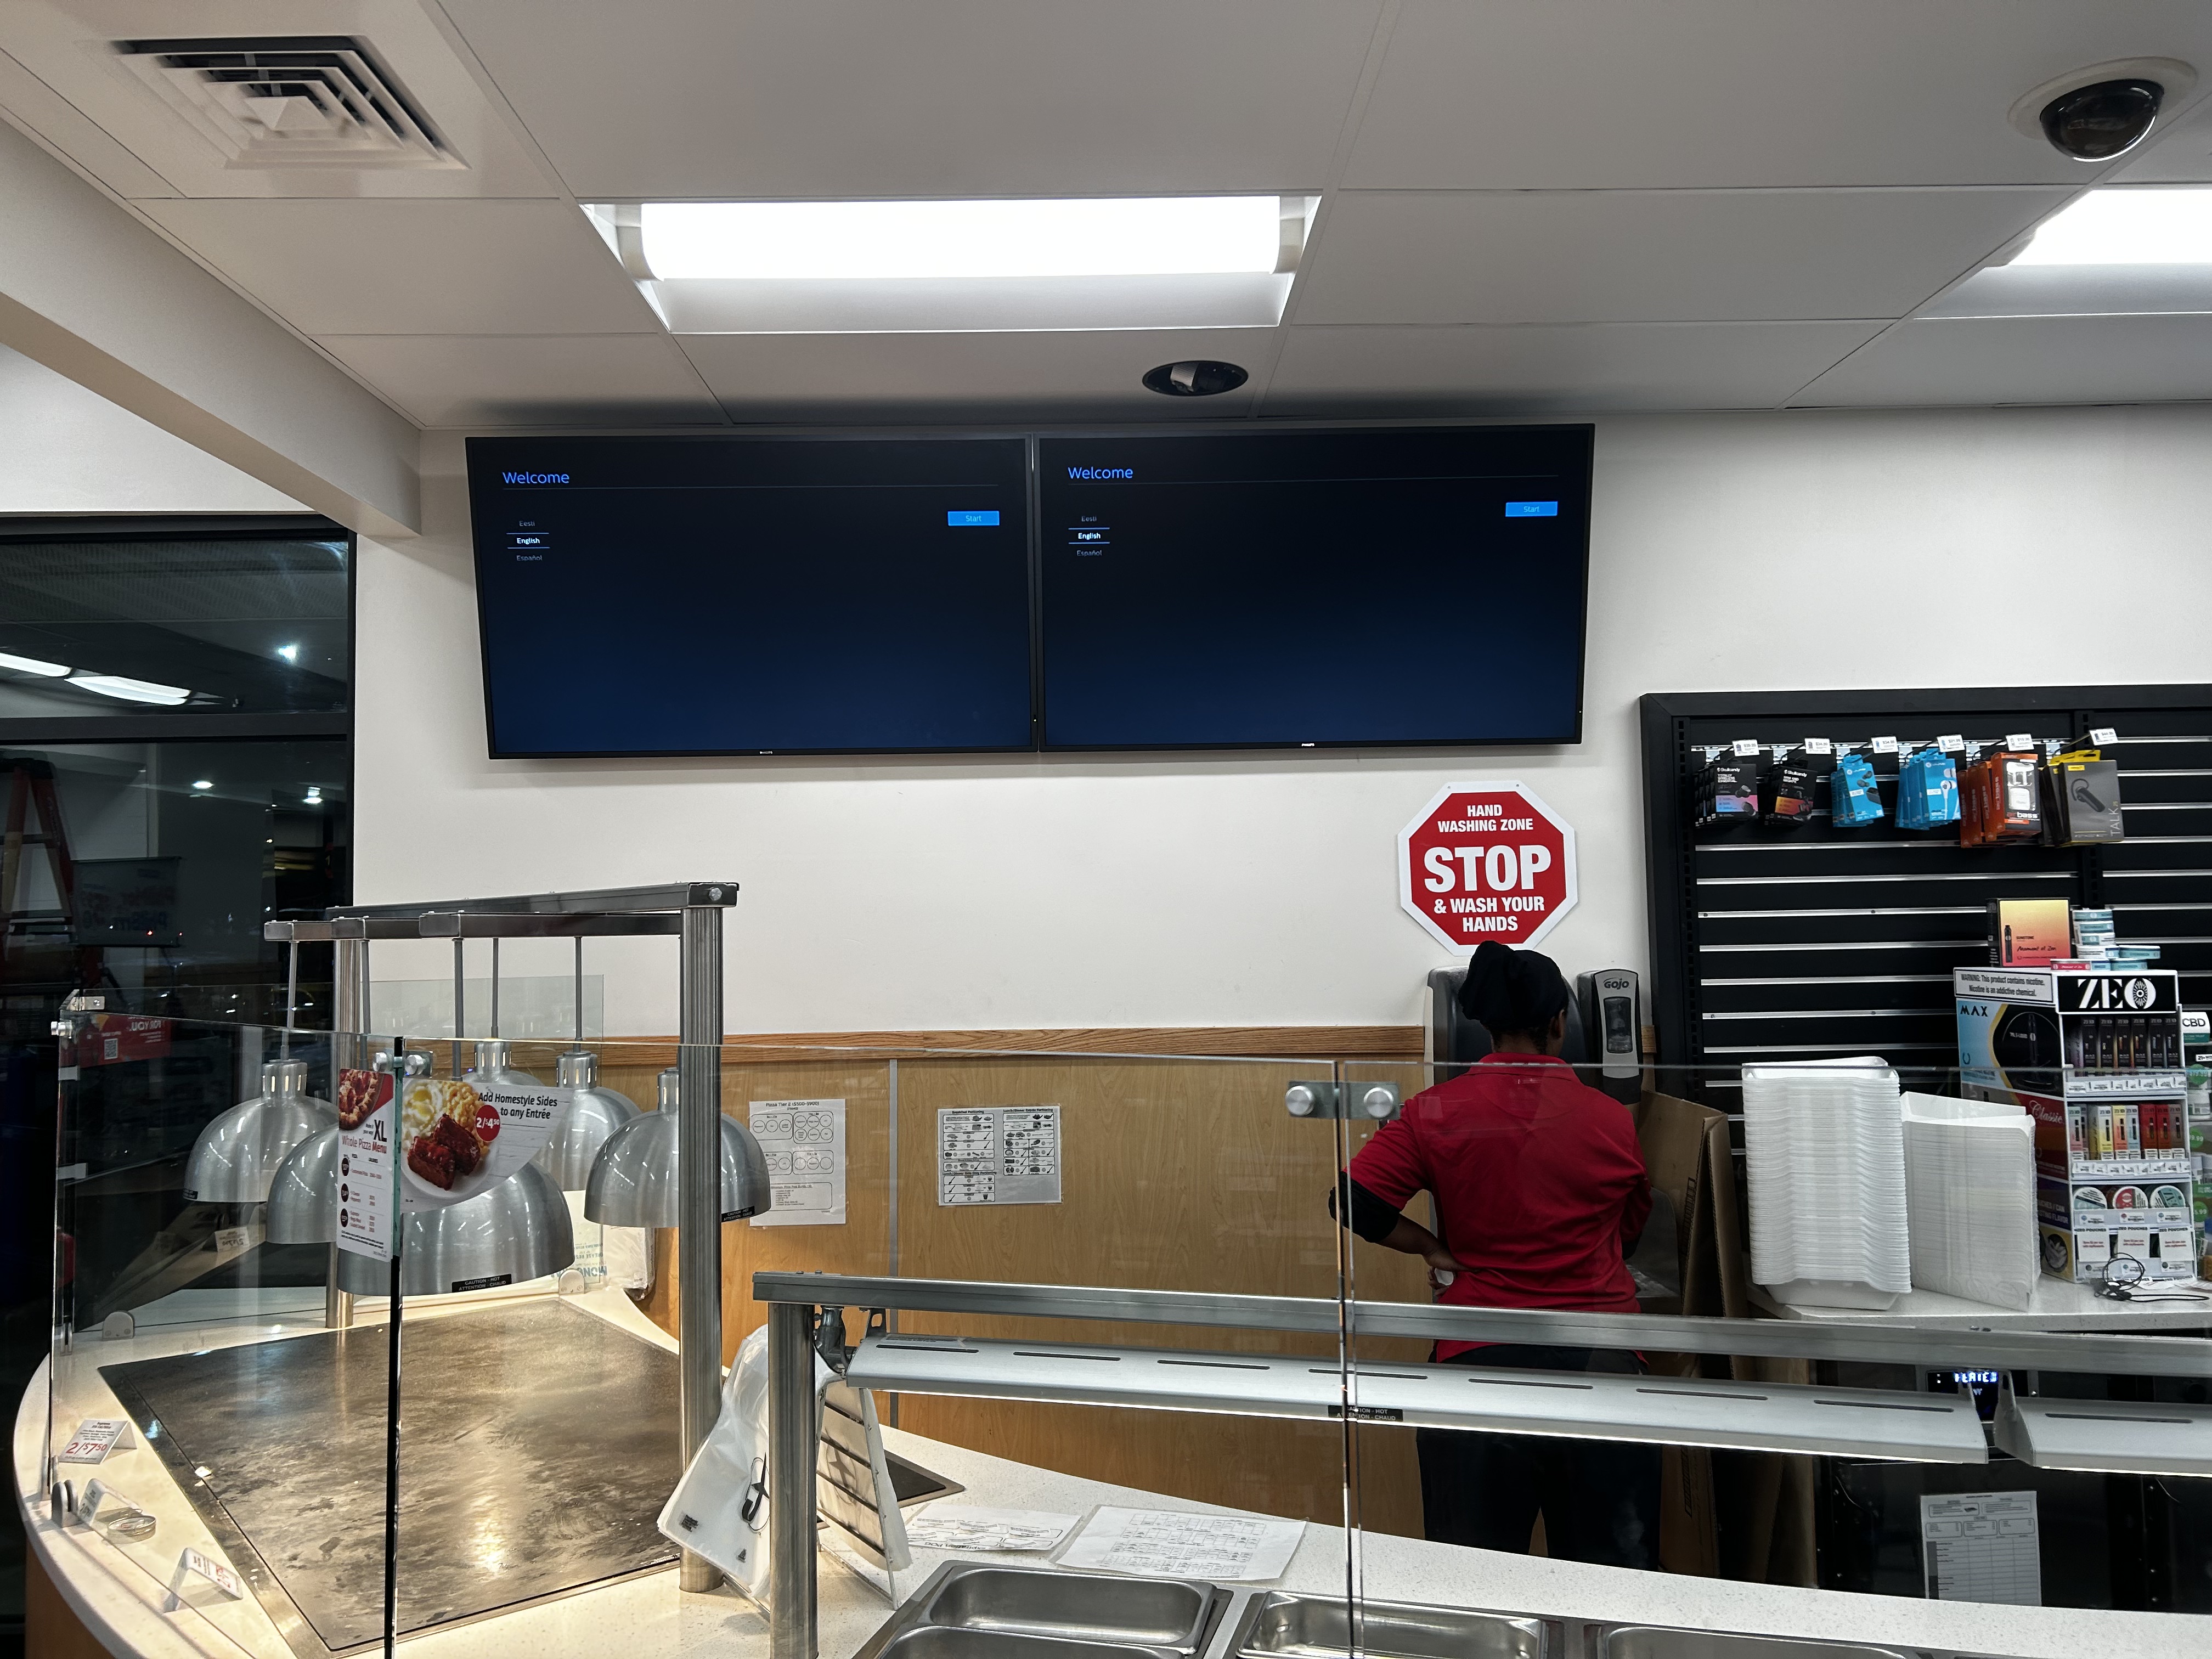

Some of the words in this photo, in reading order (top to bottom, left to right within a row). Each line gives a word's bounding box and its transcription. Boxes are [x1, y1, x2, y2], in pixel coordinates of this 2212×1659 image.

[502, 471, 569, 484] Welcome
[1068, 466, 1133, 479] Welcome
[1467, 804, 1503, 817] HAND
[1437, 820, 1497, 833] WASHING
[1500, 819, 1533, 831] ZONE
[2108, 808, 2121, 837] TALK
[1424, 844, 1551, 893] STOP
[1434, 899, 1447, 915] &
[1451, 898, 1497, 913] WASH
[1502, 896, 1545, 912] YOUR
[1463, 916, 1518, 933] HANDS
[1990, 975, 2007, 984] product
[2007, 977, 2025, 985] contains
[2026, 978, 2045, 986] nicotine.
[1996, 986, 2015, 995] addictive
[2016, 988, 2036, 997] chemical.
[1960, 1005, 1988, 1017] MAX
[2182, 1018, 2206, 1027] CBD
[478, 1092, 493, 1102] Add
[495, 1093, 535, 1107] Homestyle
[537, 1096, 557, 1107] Sides
[500, 1107, 508, 1116] to
[510, 1110, 524, 1119] any
[526, 1108, 551, 1119] Entrée
[2029, 1100, 2063, 1124] Classic
[374, 1119, 387, 1142] XL
[342, 1135, 358, 1147] Whole
[359, 1137, 371, 1150] Pizza
[372, 1141, 387, 1154] Menu
[2056, 1204, 2065, 1212] CAN
[2052, 1214, 2069, 1224] FLAVOR
[459, 1283, 486, 1291] ATTENTION
